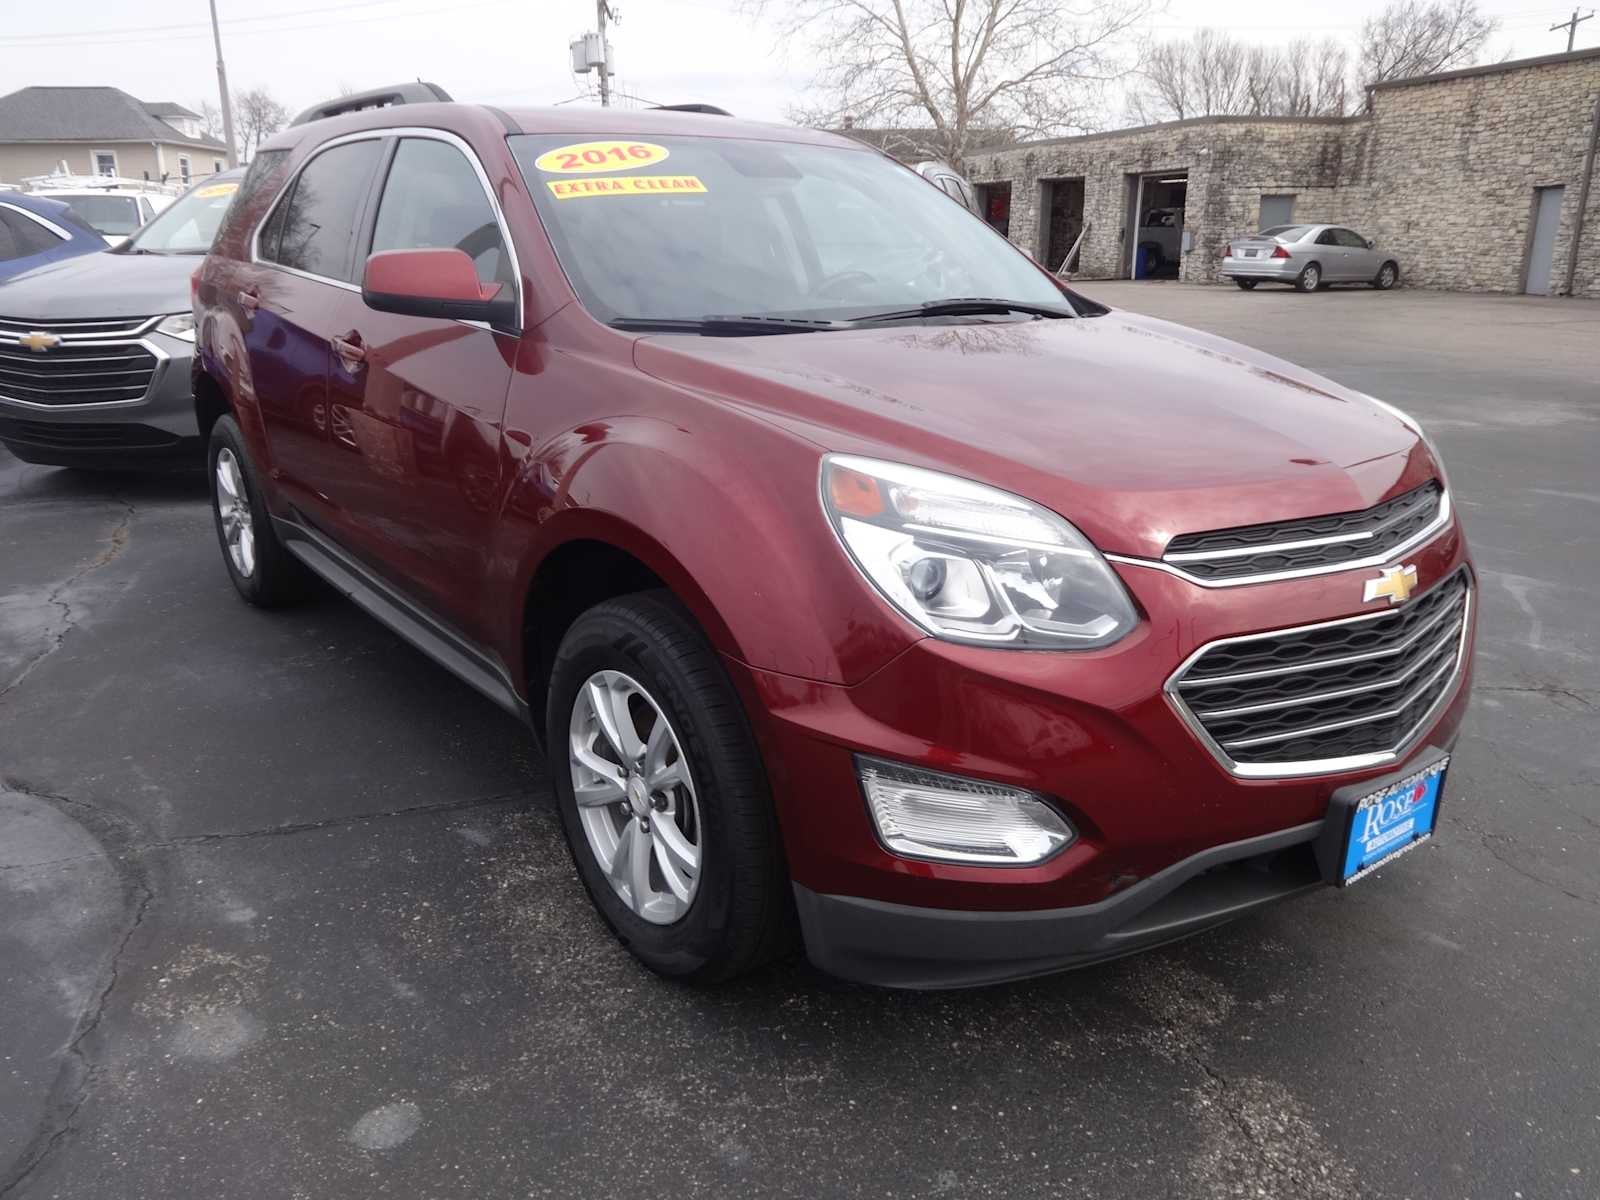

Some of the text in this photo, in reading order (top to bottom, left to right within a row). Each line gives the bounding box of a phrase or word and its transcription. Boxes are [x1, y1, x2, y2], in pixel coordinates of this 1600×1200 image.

[556, 144, 652, 169] 2016
[553, 178, 701, 195] EXTRA CLEAN
